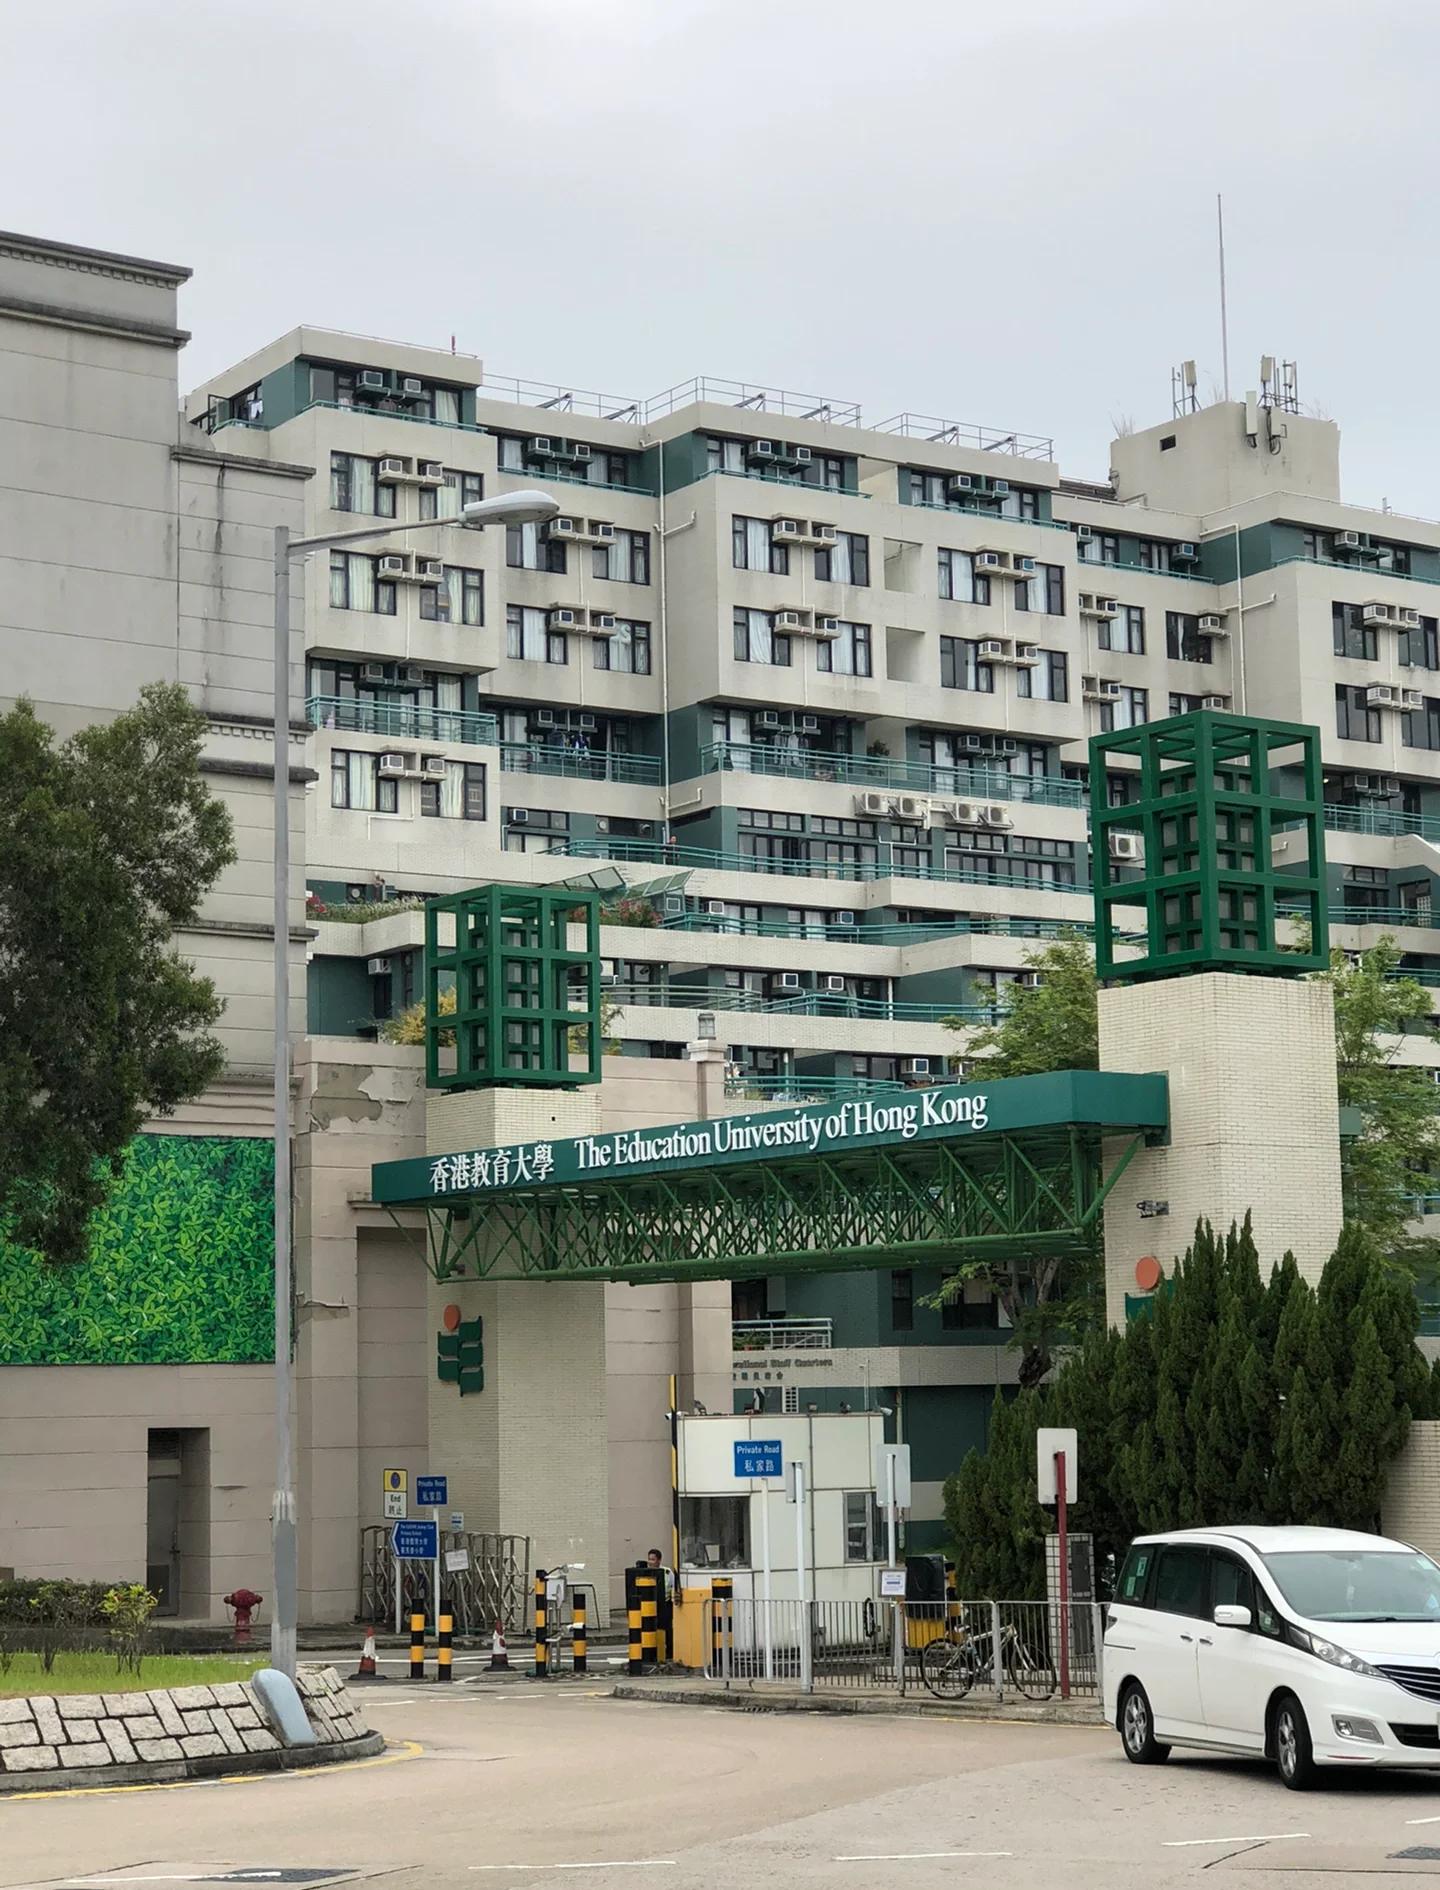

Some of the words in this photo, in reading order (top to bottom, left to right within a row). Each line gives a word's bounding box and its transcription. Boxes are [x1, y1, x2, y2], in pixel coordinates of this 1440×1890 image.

[574, 1137, 611, 1169] The
[613, 1125, 712, 1165] Education
[711, 1109, 824, 1151] University
[825, 1103, 853, 1140] of
[852, 1100, 919, 1138] Hong
[920, 1091, 988, 1130] Kong
[429, 1143, 555, 1193] 香港教育大學
[736, 1445, 763, 1455] Private
[763, 1444, 780, 1454] Road
